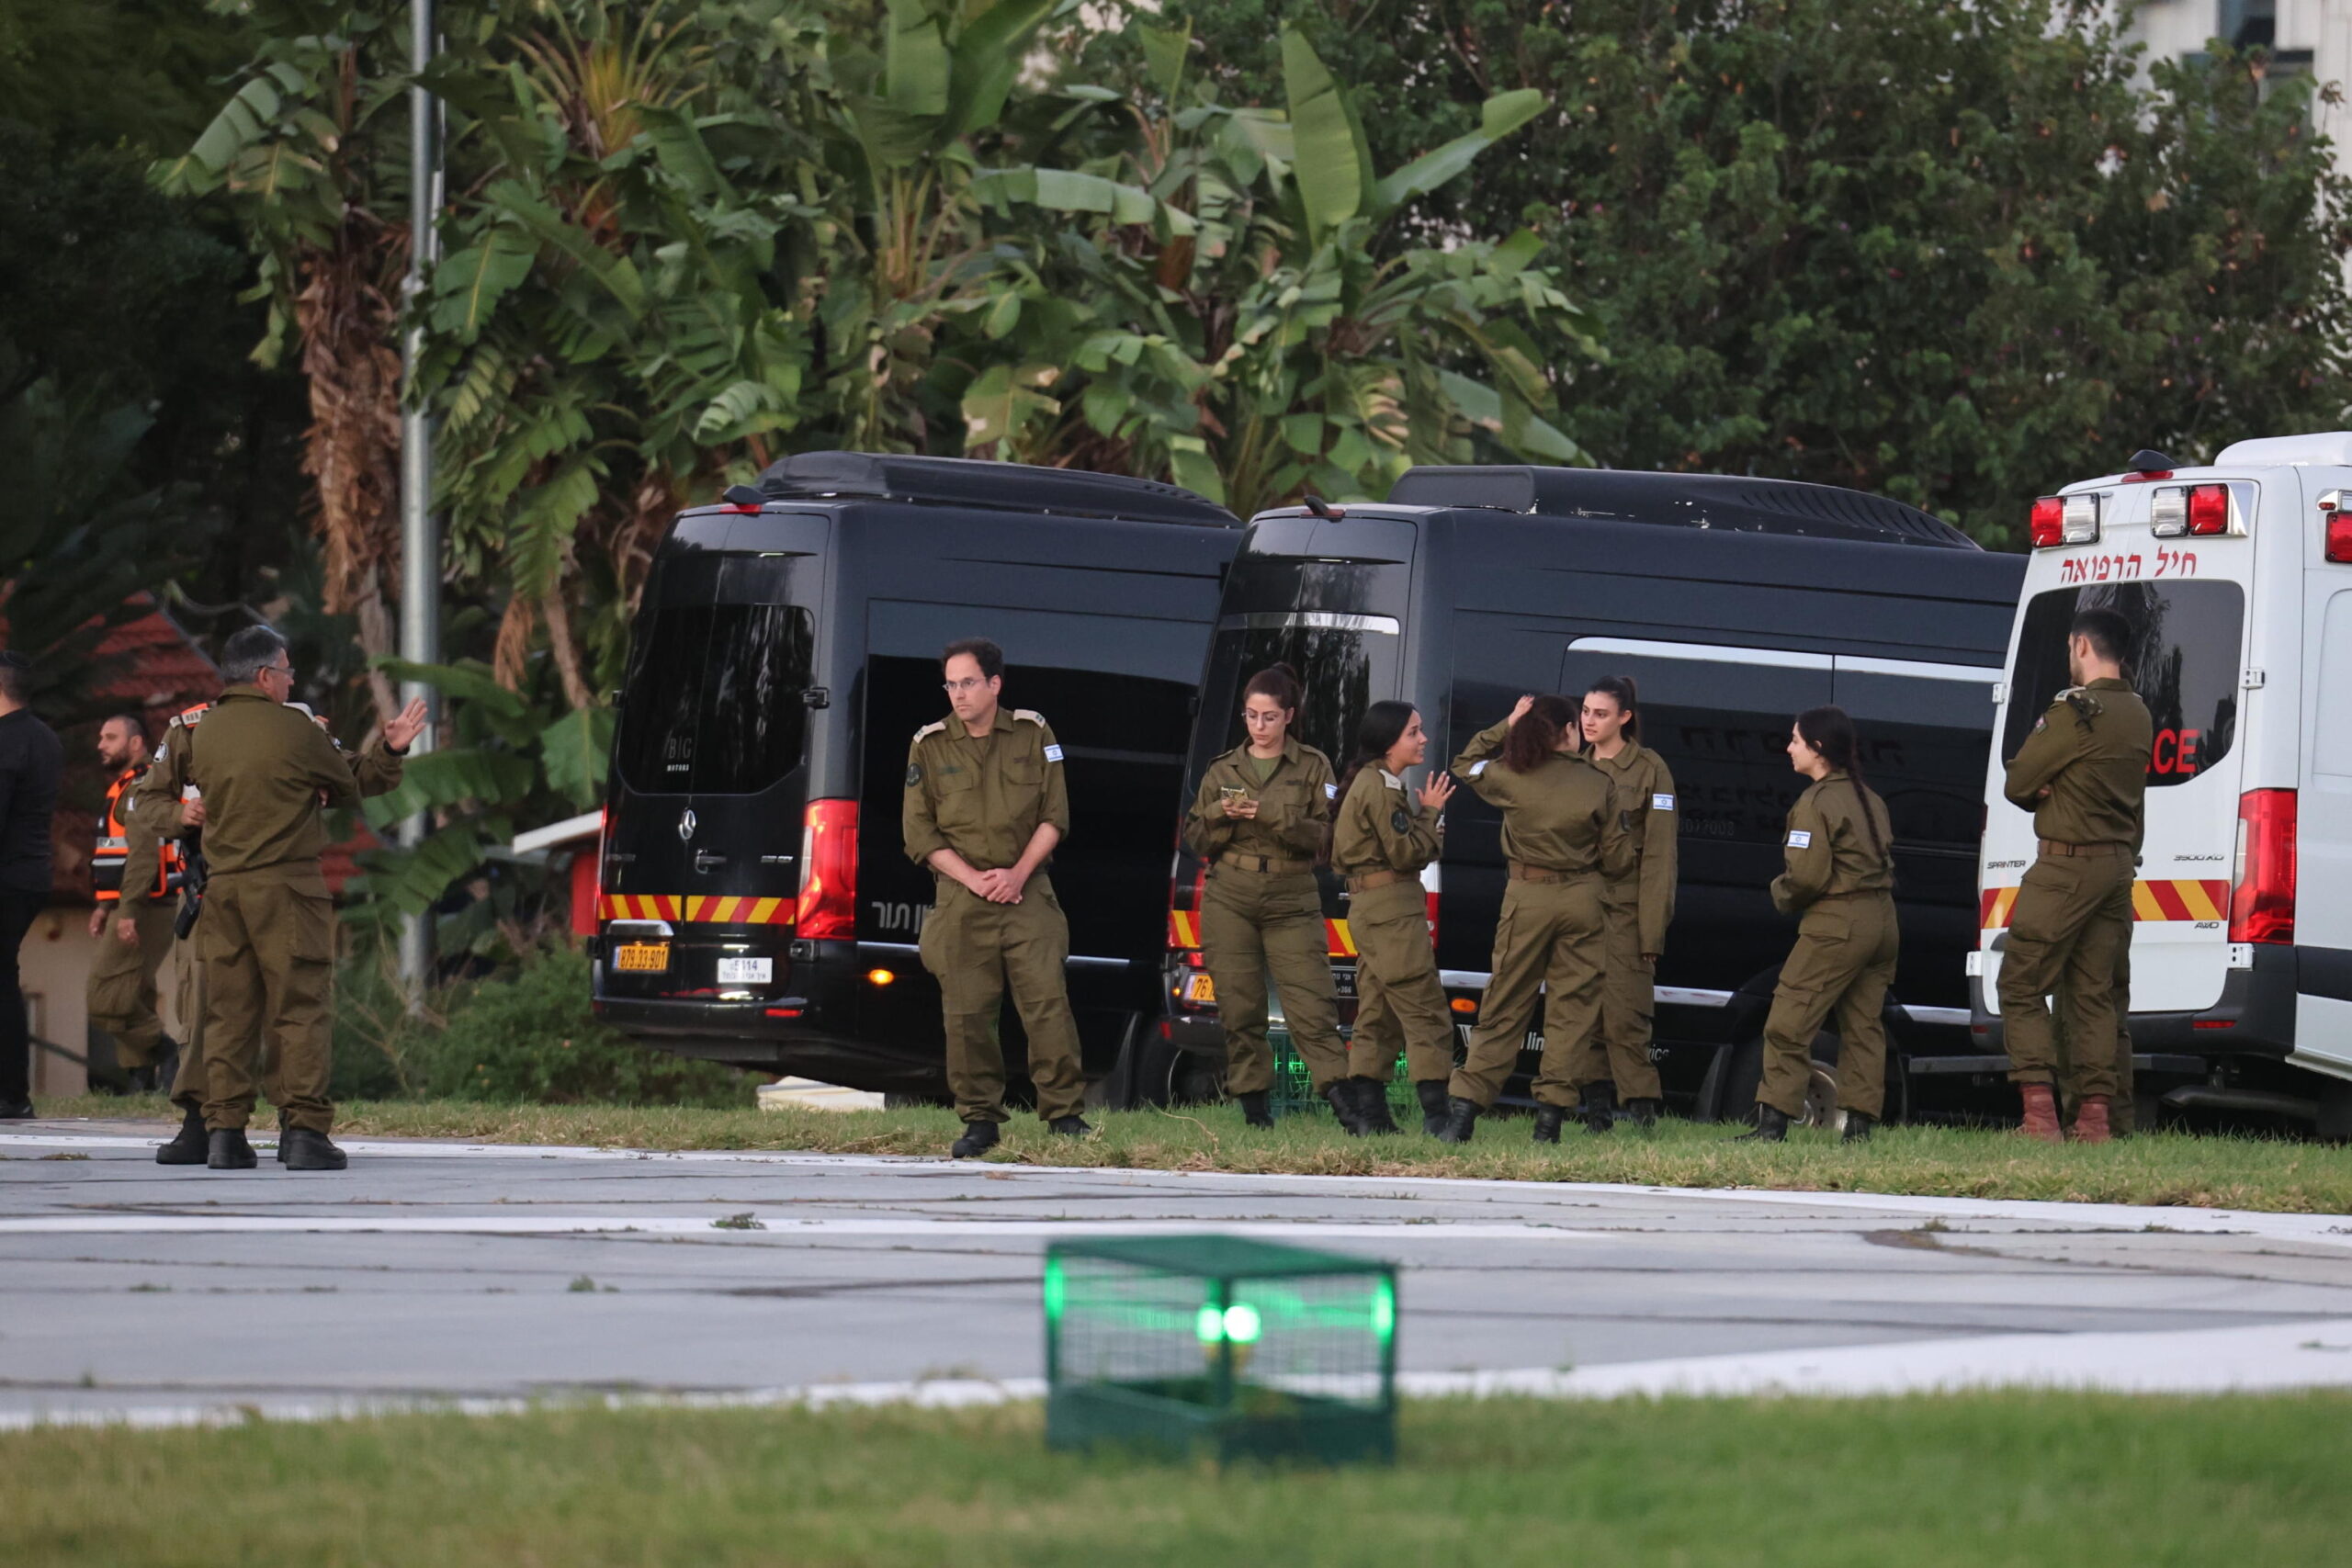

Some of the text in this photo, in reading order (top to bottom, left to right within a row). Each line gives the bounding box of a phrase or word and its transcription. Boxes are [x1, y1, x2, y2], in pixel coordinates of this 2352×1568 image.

[2060, 545, 2197, 584] חיל הרפואה
[2145, 728, 2199, 774] CE
[1987, 860, 2027, 870] SPRINTER
[2194, 921, 2220, 930] AWD
[1526, 1031, 1545, 1052] lin
